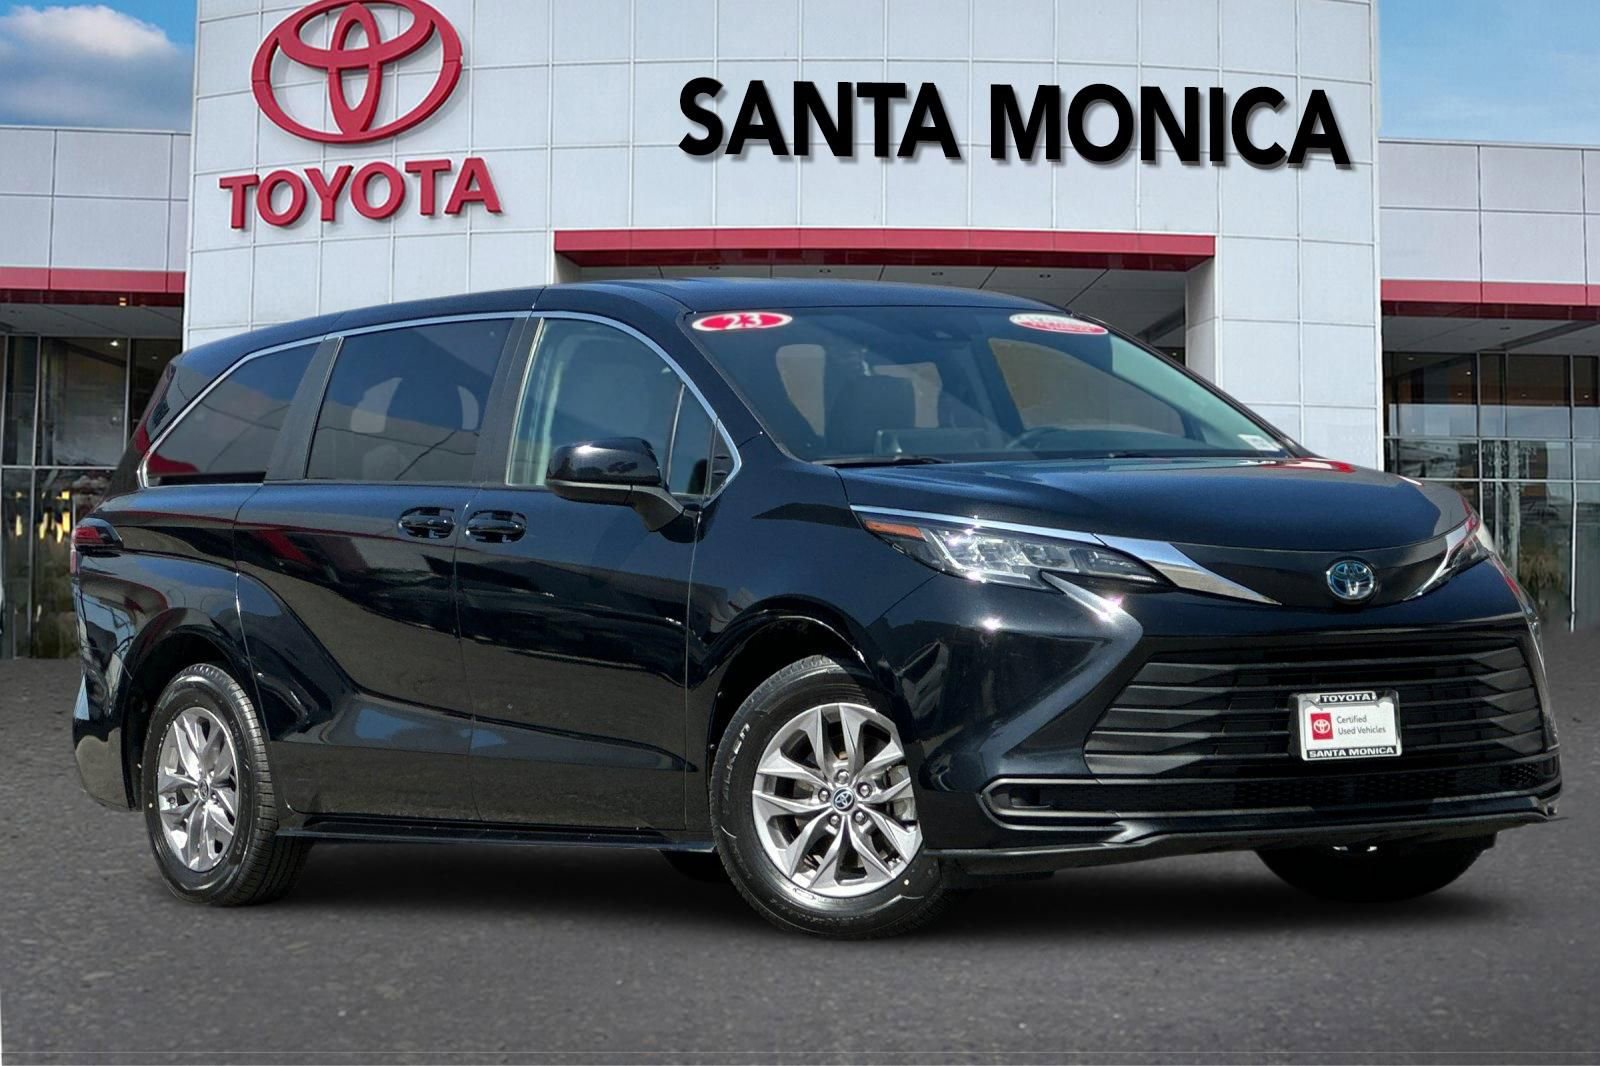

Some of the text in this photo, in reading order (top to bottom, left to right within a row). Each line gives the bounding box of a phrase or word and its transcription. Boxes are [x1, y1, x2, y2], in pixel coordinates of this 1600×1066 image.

[678, 77, 1351, 169] SANTA MONICA
[219, 156, 503, 230] TOYOTA
[723, 312, 763, 330] 23
[1321, 693, 1371, 702] TOYOTA
[1336, 714, 1368, 724] Certified
[1357, 726, 1387, 734] Vehicles
[1309, 746, 1395, 758] SANTA MONICA
